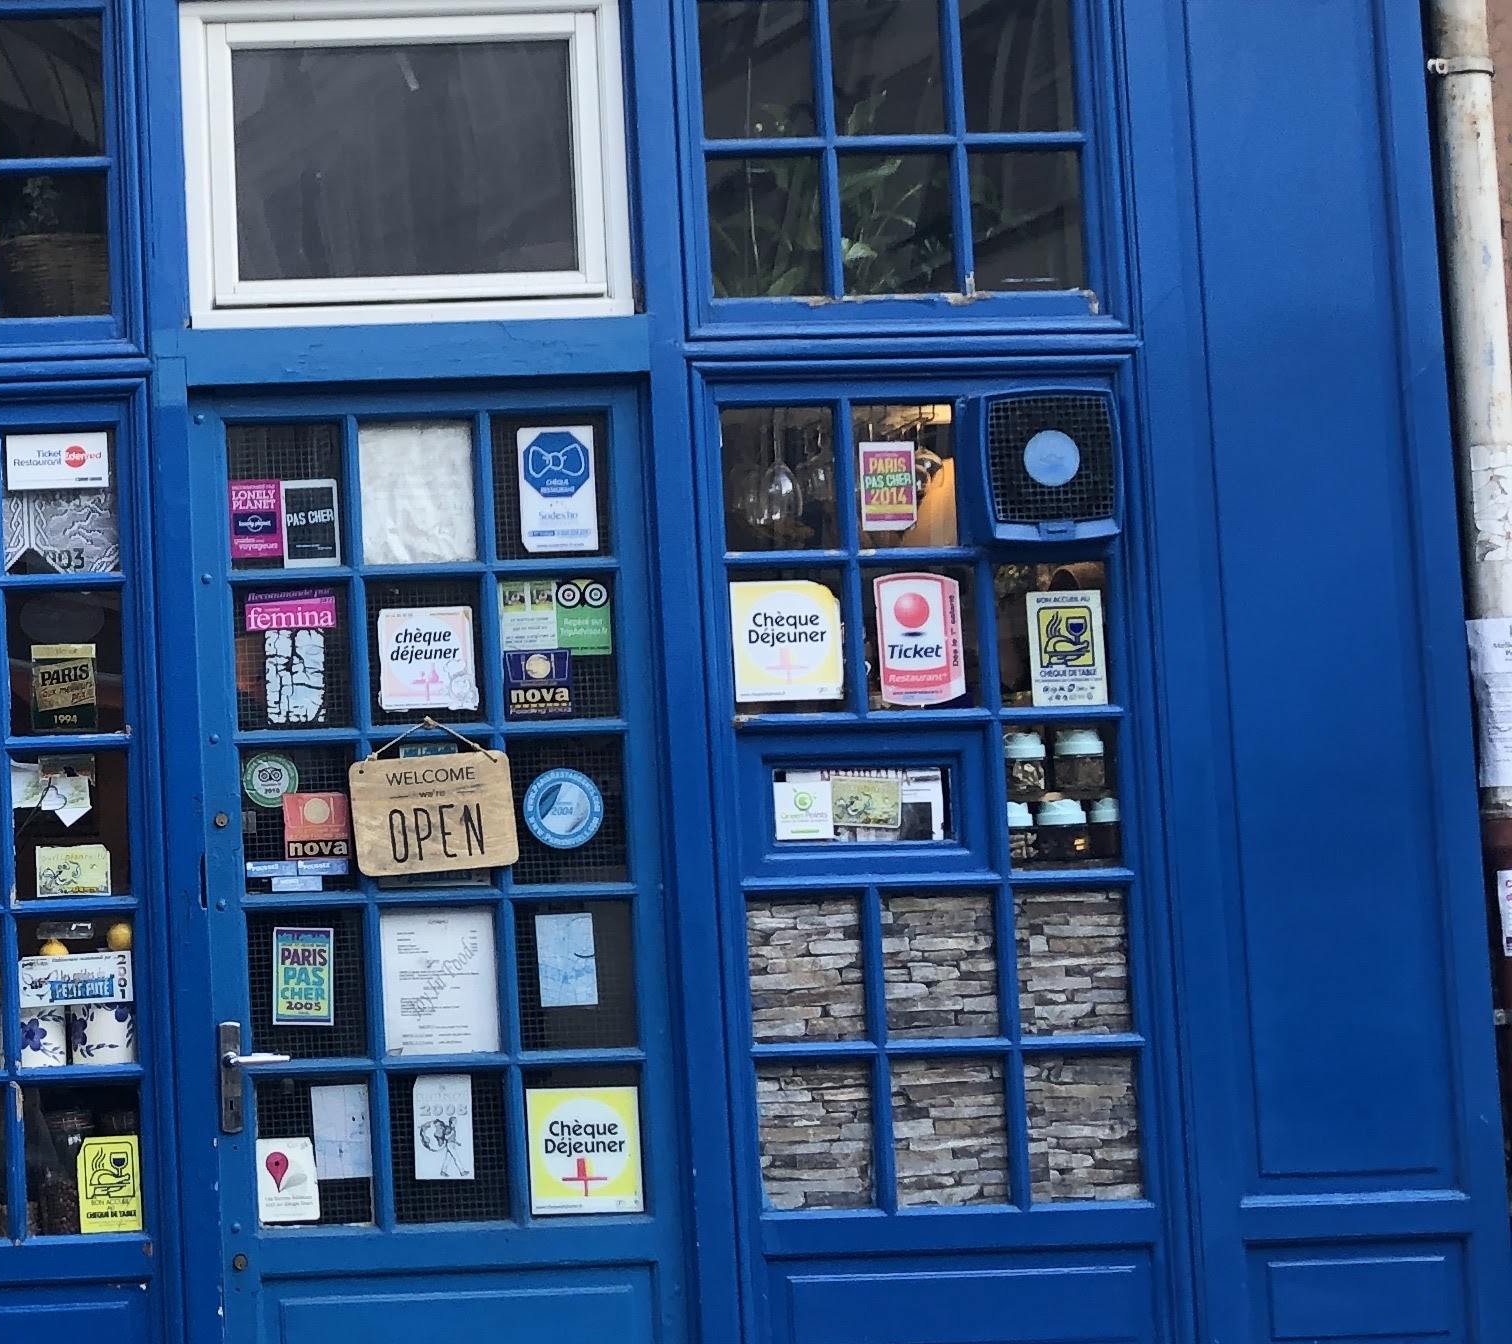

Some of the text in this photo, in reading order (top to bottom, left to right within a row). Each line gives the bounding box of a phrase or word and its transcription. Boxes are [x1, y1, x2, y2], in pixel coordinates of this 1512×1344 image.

[13, 457, 62, 468] Restaurant
[35, 449, 62, 459] Ticket
[64, 450, 103, 462] Edenred
[868, 456, 907, 474] PARIS
[865, 472, 912, 490] PAS CHER
[231, 489, 276, 501] LONELY
[870, 486, 908, 505] 2014
[232, 499, 276, 511] PLANET
[286, 508, 335, 527] PAS CHER
[247, 606, 335, 630] femina
[752, 610, 820, 630] Chèque
[394, 627, 452, 647] chèque
[748, 627, 827, 648] Déjeuner
[390, 644, 460, 665] déjeuner
[888, 643, 943, 660] Ticket
[40, 663, 90, 687] PARIS
[888, 673, 944, 683] Restaurant
[510, 687, 570, 703] nova
[53, 714, 78, 724] 1994
[385, 766, 476, 787] WELCOME
[550, 806, 574, 816] 2004
[388, 802, 485, 864] OPEN
[288, 840, 348, 857] nova
[280, 947, 328, 967] PARIS
[283, 966, 325, 987] PAS
[280, 986, 326, 1001] CHER
[285, 1000, 322, 1011] 2005
[548, 1118, 619, 1139] Chèque
[544, 1136, 626, 1158] Déjeuner
